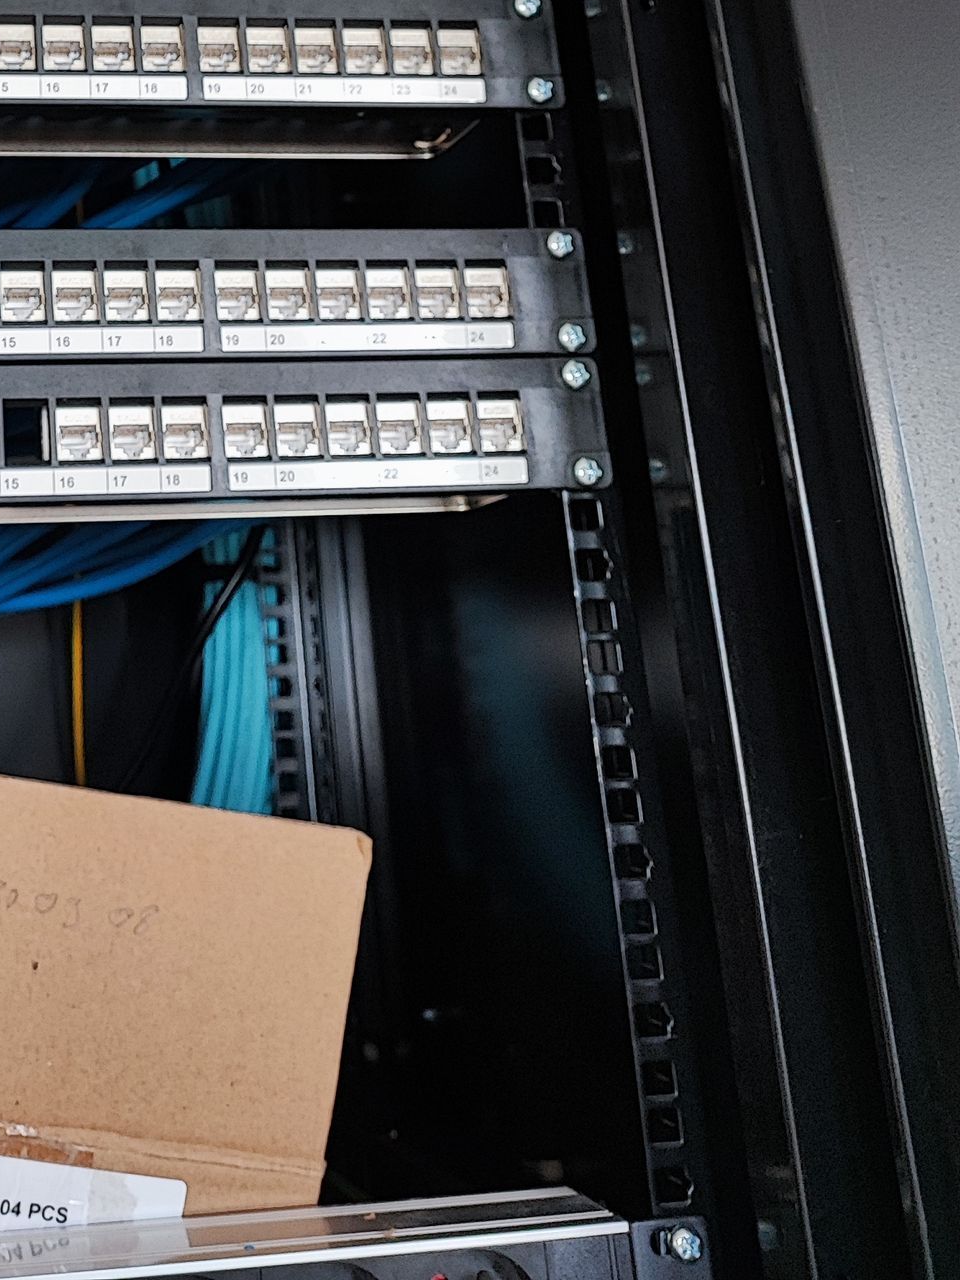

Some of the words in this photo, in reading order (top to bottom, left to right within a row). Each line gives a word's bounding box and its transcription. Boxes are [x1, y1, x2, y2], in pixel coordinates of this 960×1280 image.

[46, 83, 61, 93] 16
[95, 83, 109, 94] 17
[143, 83, 158, 94] 18
[207, 83, 221, 94] 19
[250, 83, 265, 94] 20
[298, 84, 313, 94] 21
[348, 84, 363, 95] 22
[396, 85, 411, 96] 23
[443, 85, 458, 96] 24
[1, 337, 17, 349] 15
[55, 336, 71, 348] 16
[107, 335, 122, 347] 17
[158, 334, 174, 347] 18
[225, 334, 240, 346] 19
[270, 334, 286, 346] 20
[372, 333, 387, 345] 22
[470, 331, 485, 343] 24
[4, 477, 20, 490] 15
[59, 477, 75, 489] 16
[113, 475, 128, 487] 17
[166, 474, 180, 486] 18
[233, 472, 249, 484] 19
[279, 471, 295, 482] 20
[384, 468, 399, 480] 22
[28, 1203, 68, 1224] PCS
